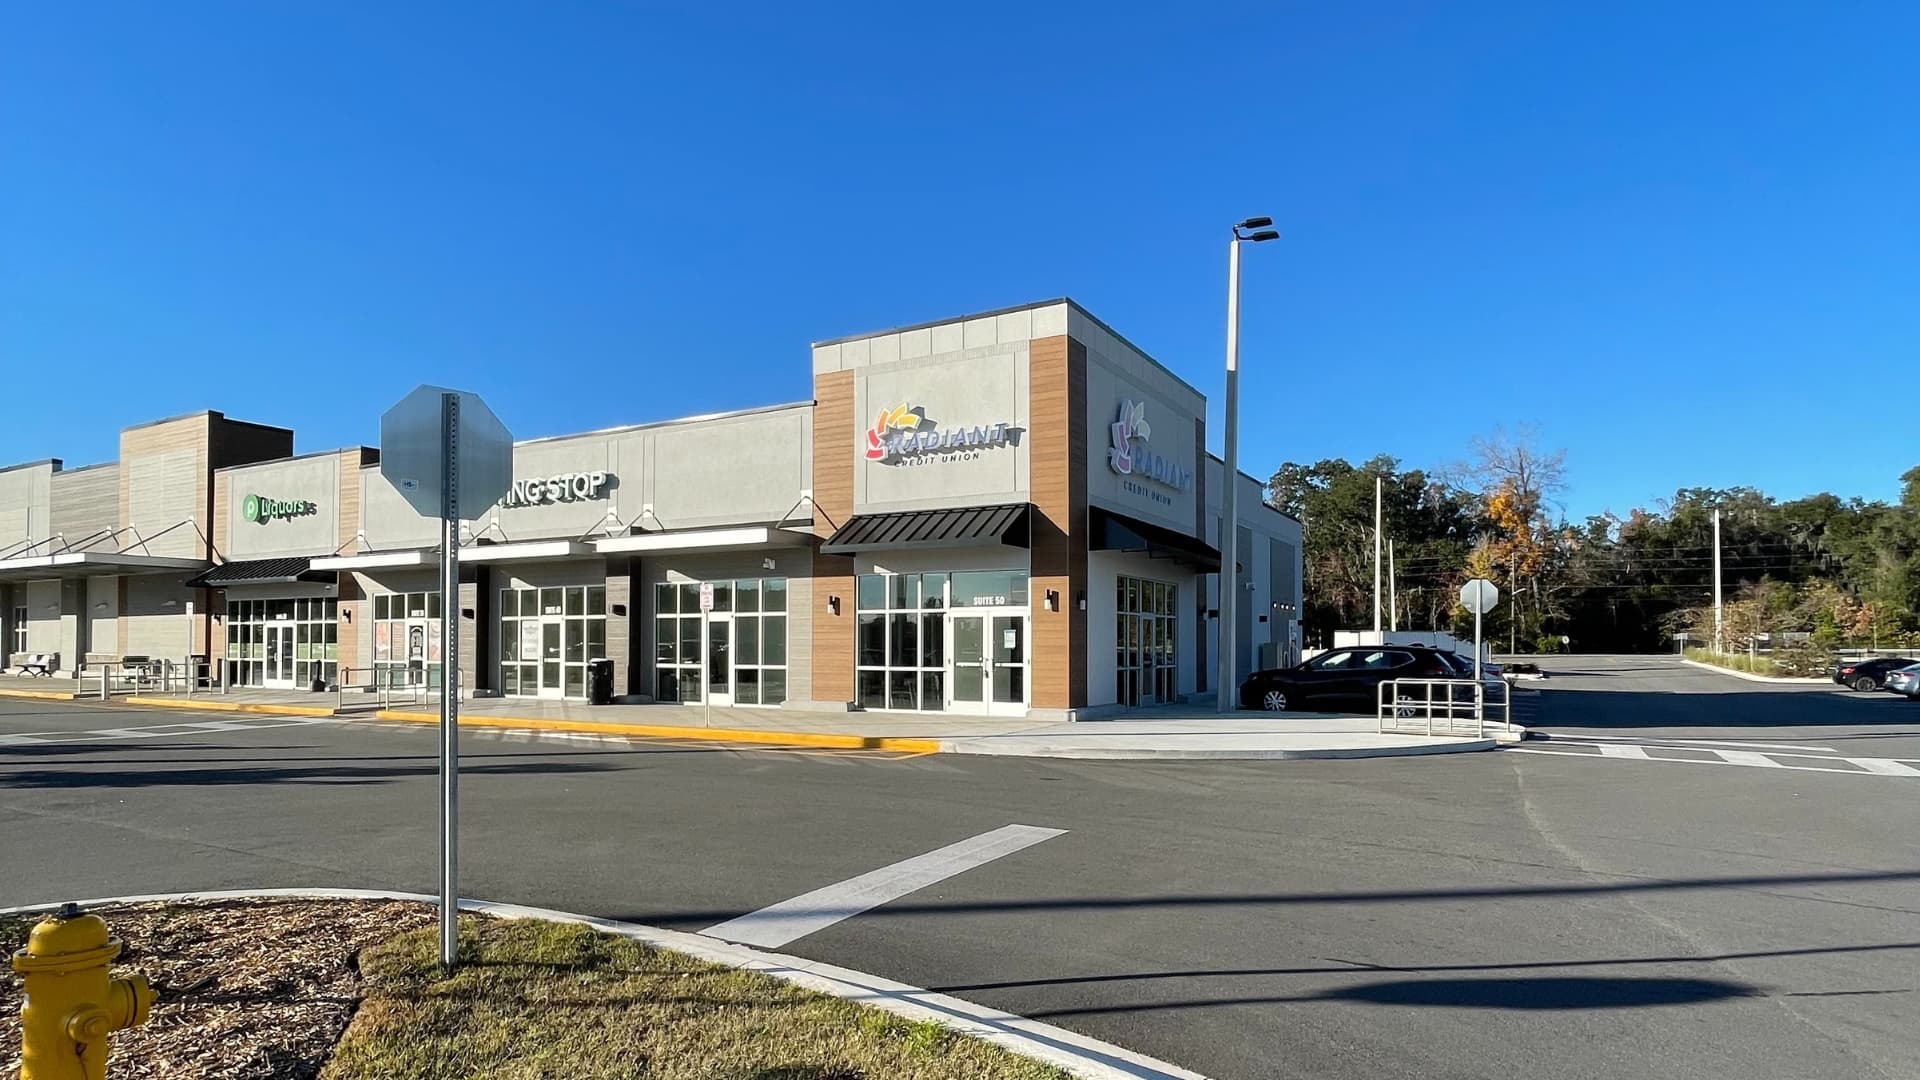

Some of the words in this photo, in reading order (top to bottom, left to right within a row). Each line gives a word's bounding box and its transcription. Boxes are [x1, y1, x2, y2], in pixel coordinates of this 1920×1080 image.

[888, 423, 1009, 454] RADIANT
[895, 457, 935, 467] CREDIT
[941, 453, 980, 463] UNION
[498, 470, 607, 504] INGSTOP
[261, 499, 305, 519] Liquors
[973, 596, 994, 606] SUITE
[994, 595, 1005, 605] 50
